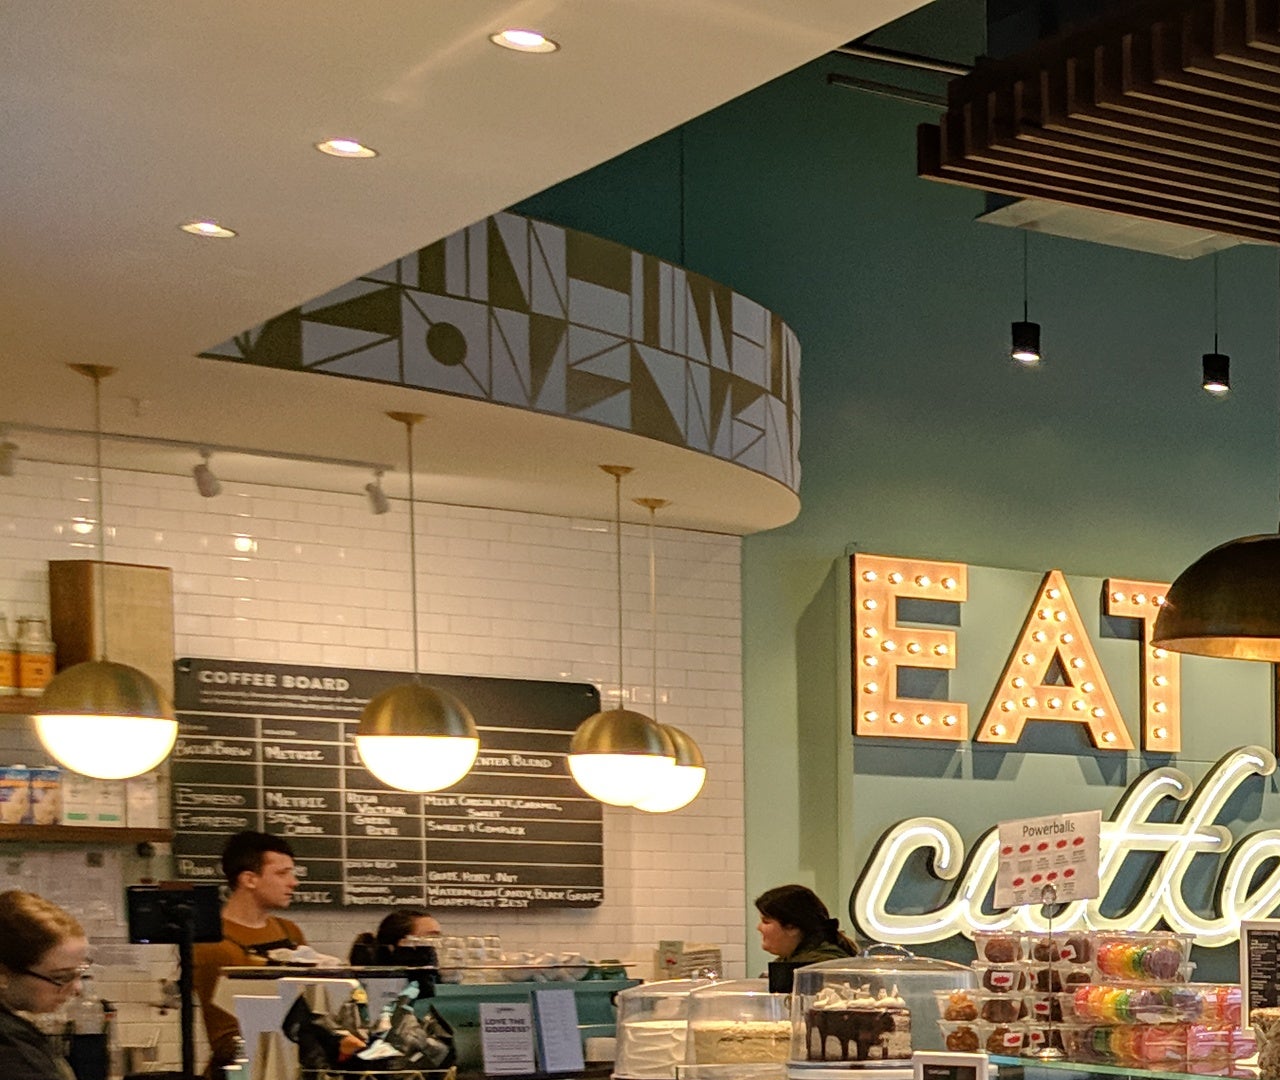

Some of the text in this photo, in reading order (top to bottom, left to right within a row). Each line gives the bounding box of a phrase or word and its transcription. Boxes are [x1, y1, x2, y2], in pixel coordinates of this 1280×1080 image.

[851, 552, 1182, 752] EAT
[199, 670, 350, 692] COFFEE BOARD
[475, 755, 552, 768] INTER BLEND
[425, 796, 457, 806] MILK
[1022, 820, 1075, 837] Powerballs
